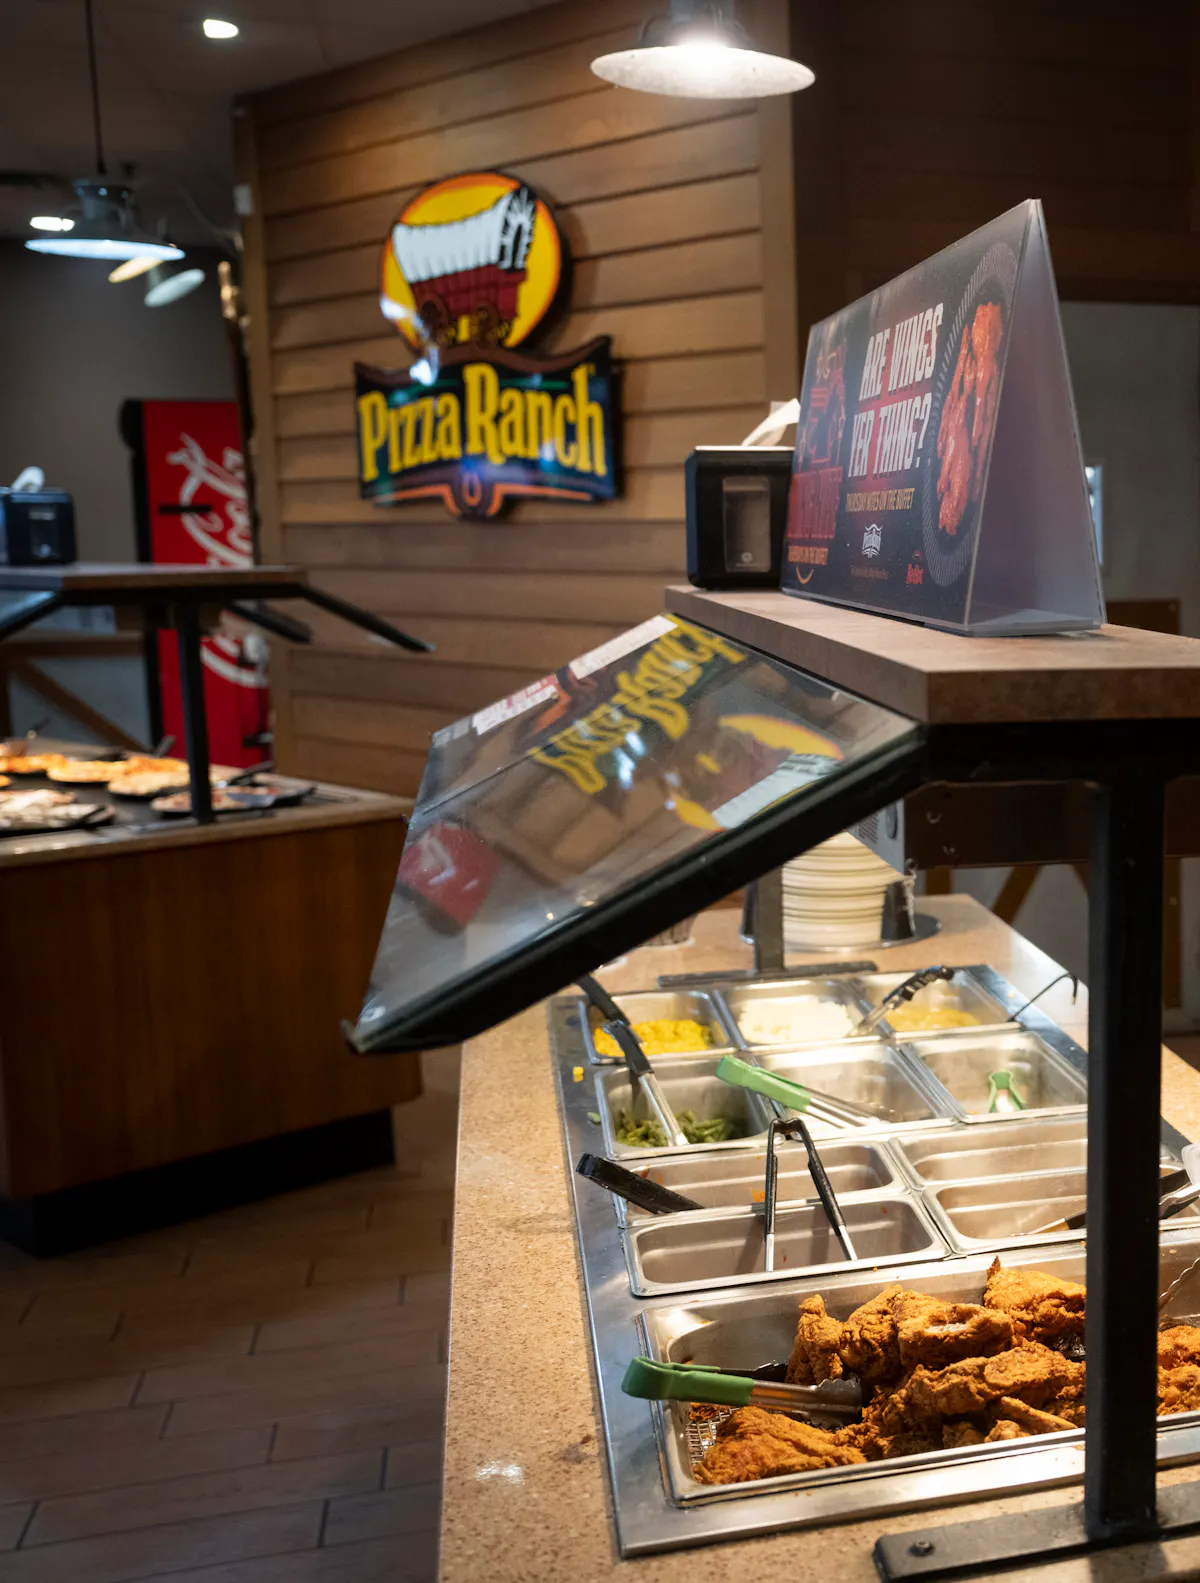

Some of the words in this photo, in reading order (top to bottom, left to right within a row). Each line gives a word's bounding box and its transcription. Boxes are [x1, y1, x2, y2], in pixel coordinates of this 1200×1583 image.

[858, 326, 890, 401] ARE
[889, 302, 944, 391] WINGS
[358, 390, 462, 482] Pizza
[463, 362, 608, 478] Ranch
[848, 411, 875, 478] YER
[872, 392, 933, 474] THING?
